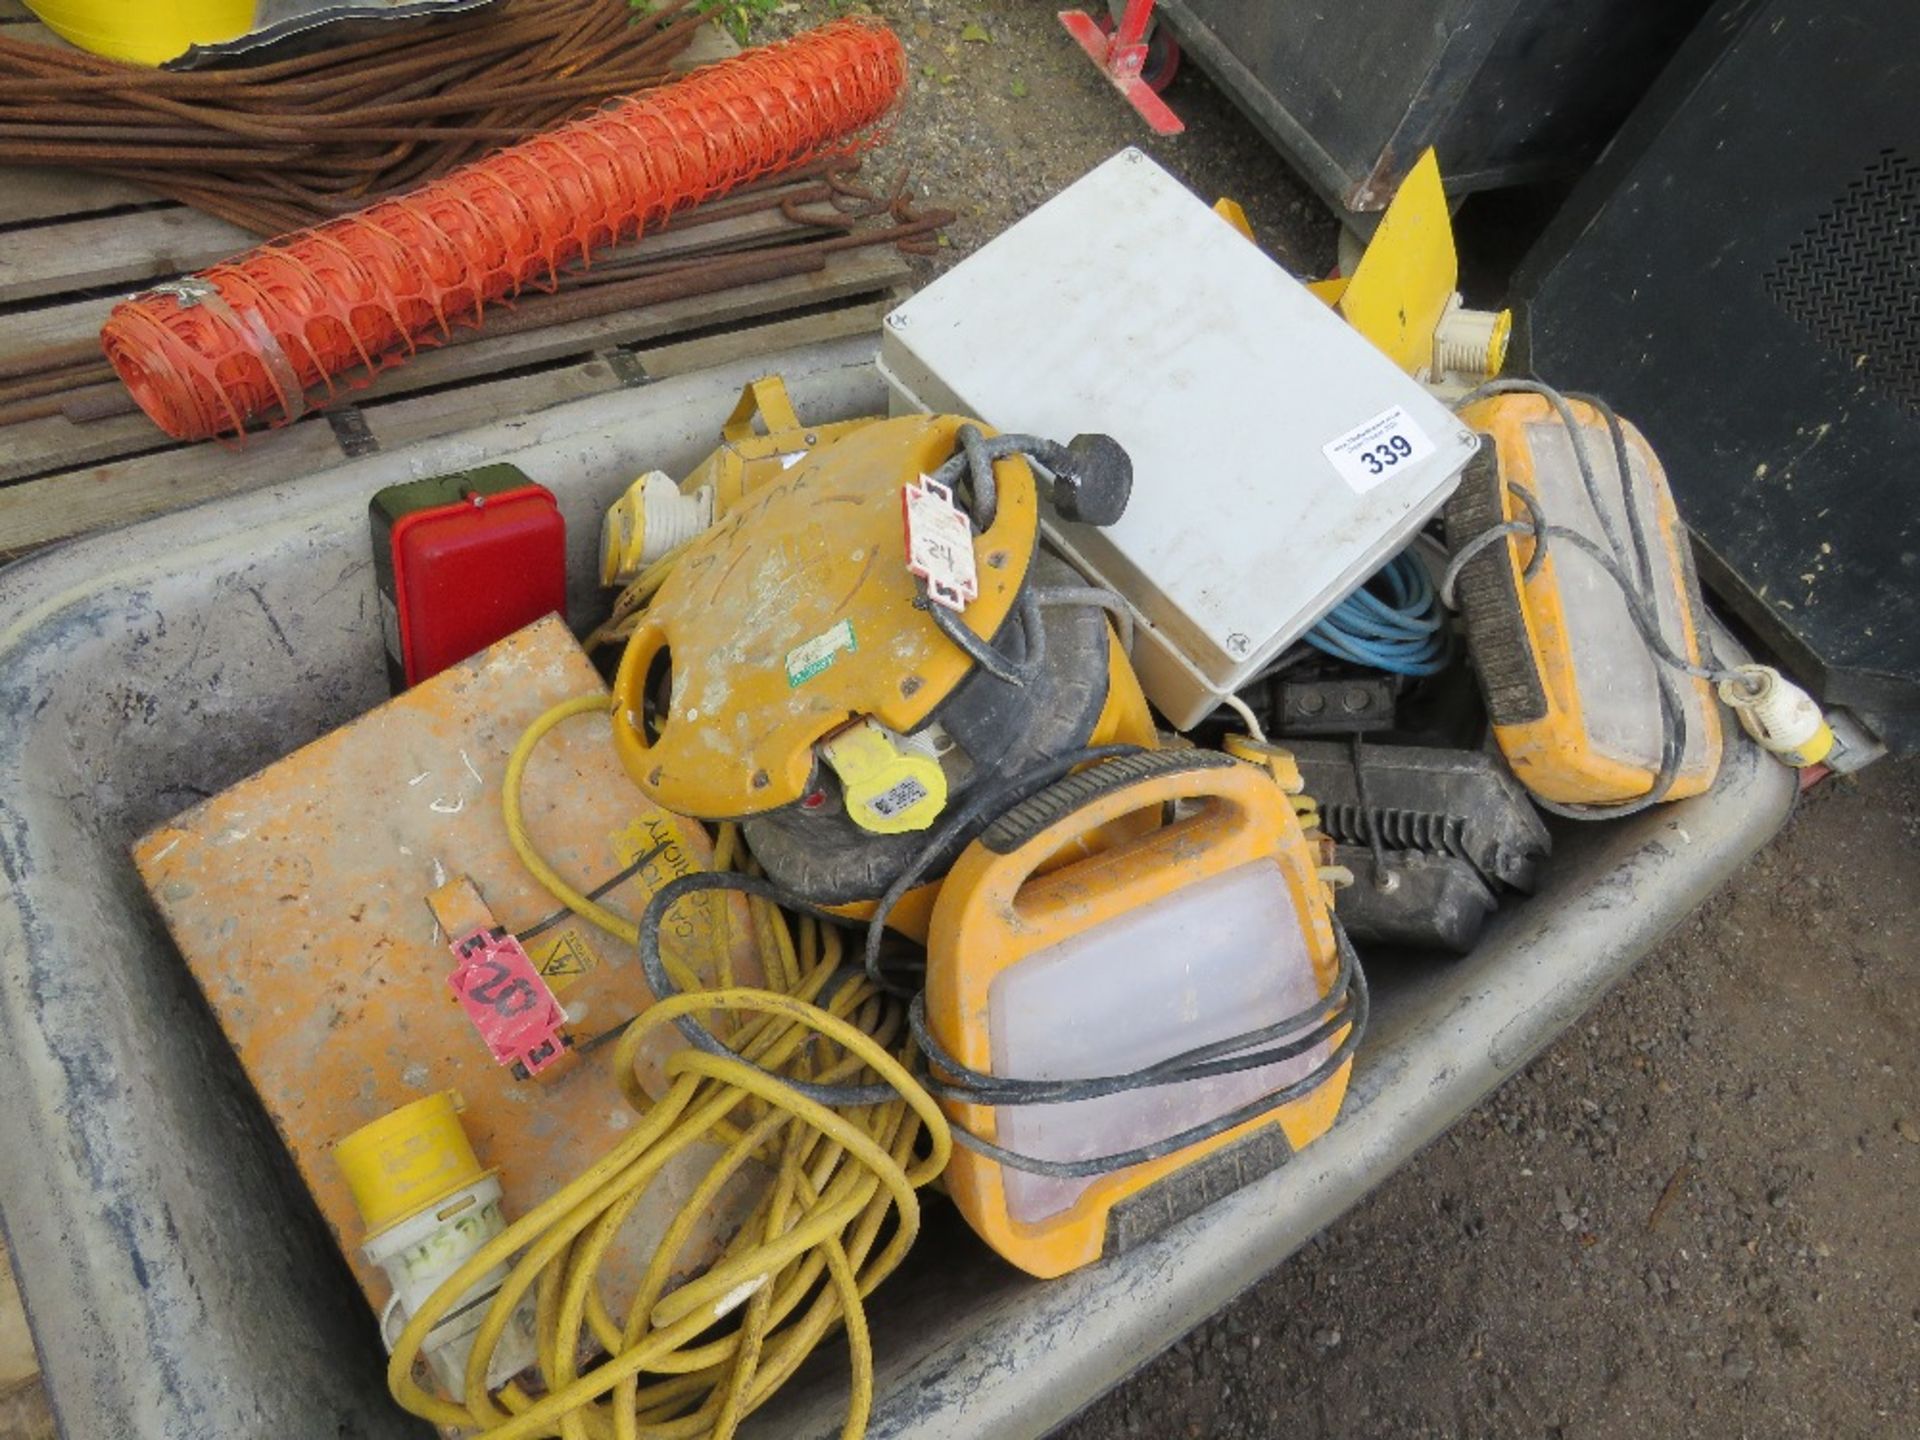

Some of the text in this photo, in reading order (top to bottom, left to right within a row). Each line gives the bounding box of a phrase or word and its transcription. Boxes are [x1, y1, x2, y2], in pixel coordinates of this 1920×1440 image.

[1360, 435, 1412, 475] 339
[631, 848, 695, 939] CAION
[468, 961, 538, 1019] 20
